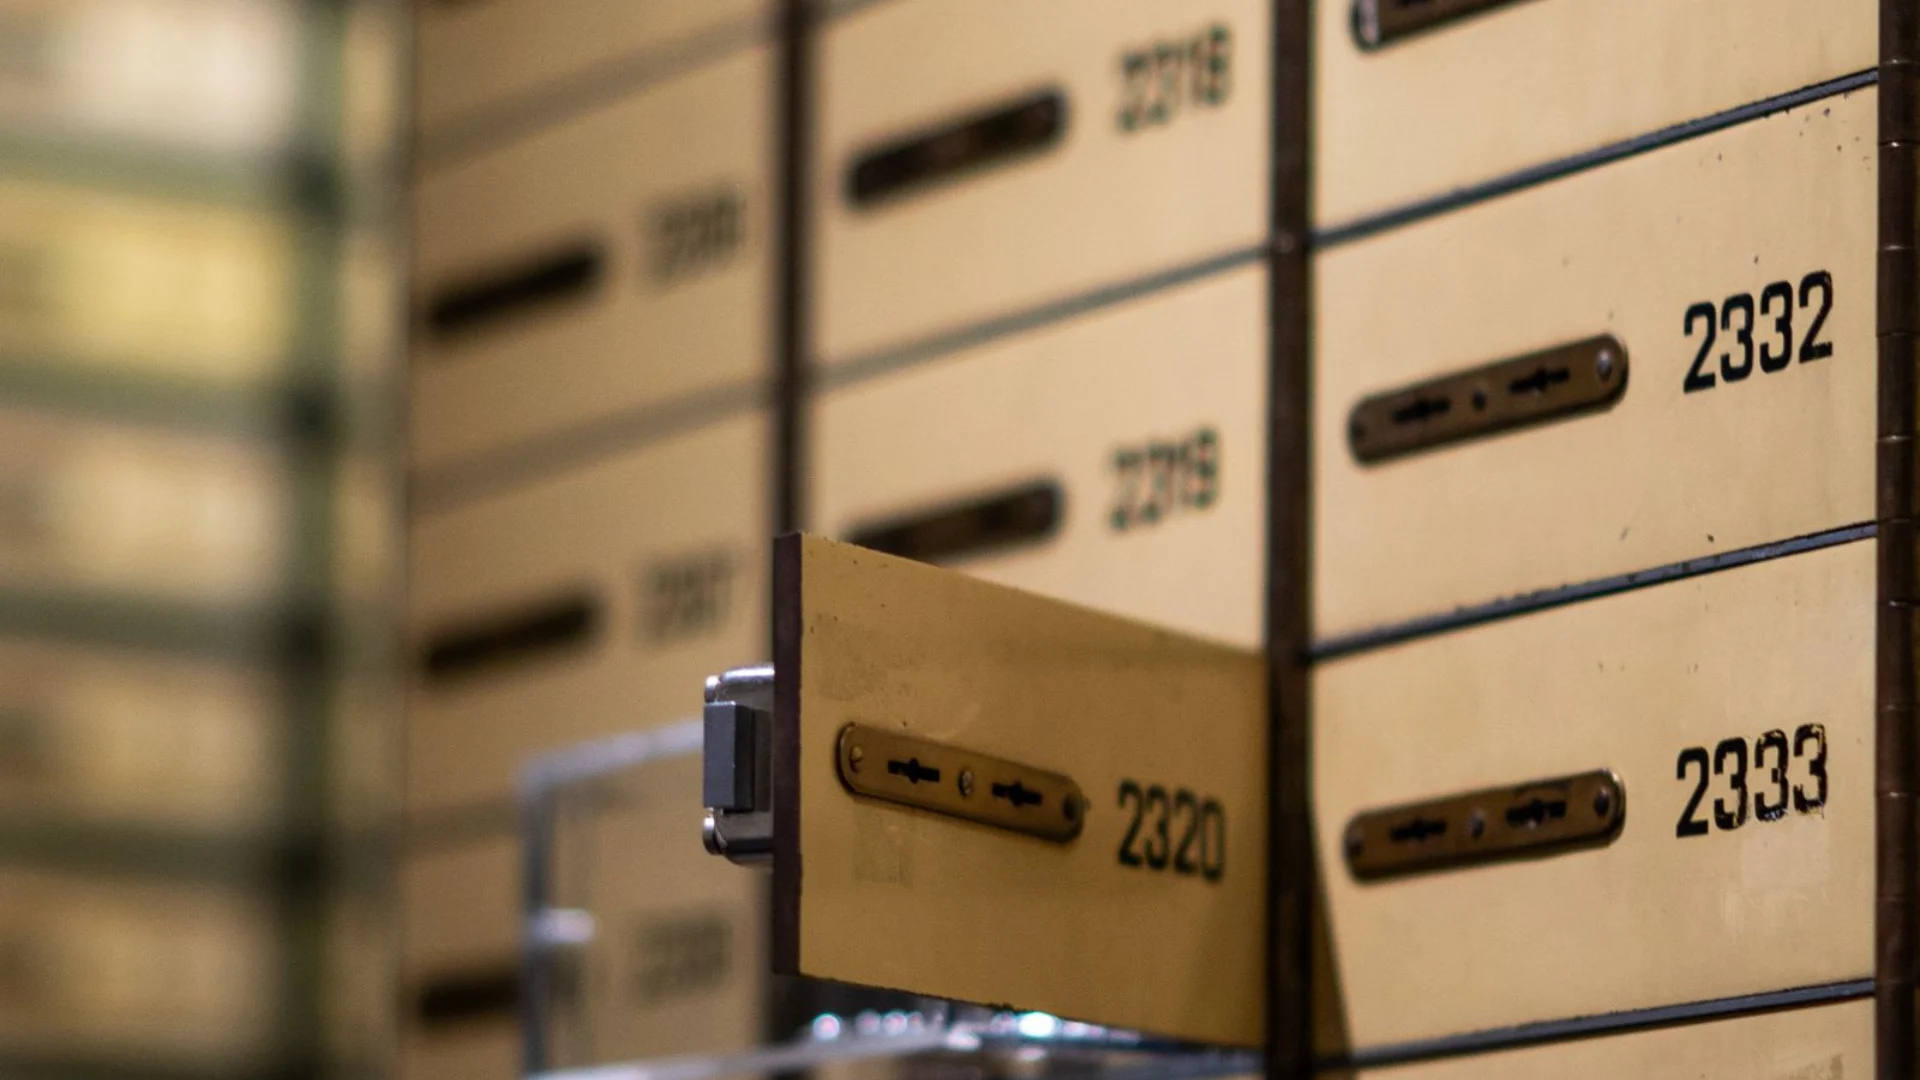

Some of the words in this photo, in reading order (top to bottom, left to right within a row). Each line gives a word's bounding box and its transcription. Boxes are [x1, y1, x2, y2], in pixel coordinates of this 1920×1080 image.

[1683, 269, 1833, 394] 2332
[1108, 427, 1220, 533] 2319
[1117, 777, 1225, 883] 2320
[1676, 722, 1828, 838] 2333
